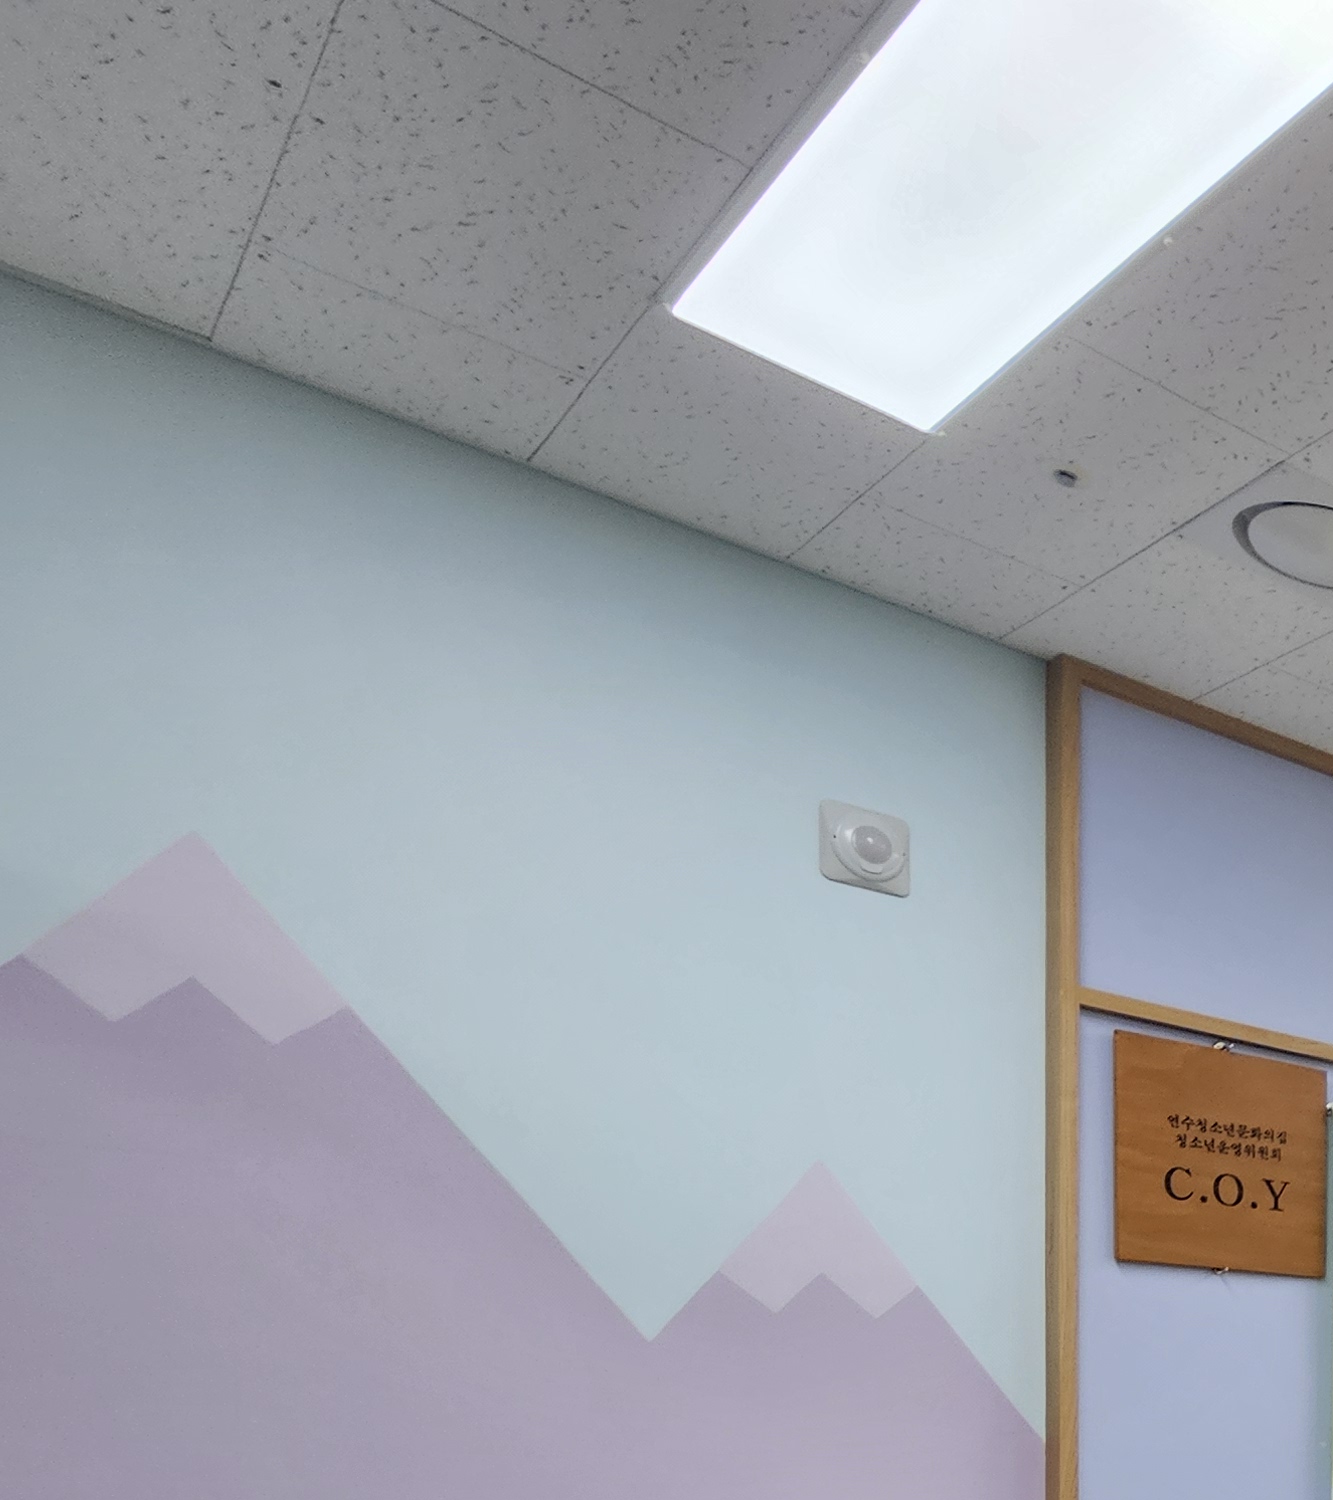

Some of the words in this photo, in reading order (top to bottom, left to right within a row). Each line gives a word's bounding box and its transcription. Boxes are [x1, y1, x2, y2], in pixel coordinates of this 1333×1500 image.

[1167, 1114, 1287, 1145] 연수청소년문화의집
[1175, 1133, 1282, 1162] 청소년운영위원회
[1164, 1166, 1290, 1212] C.O.Y
